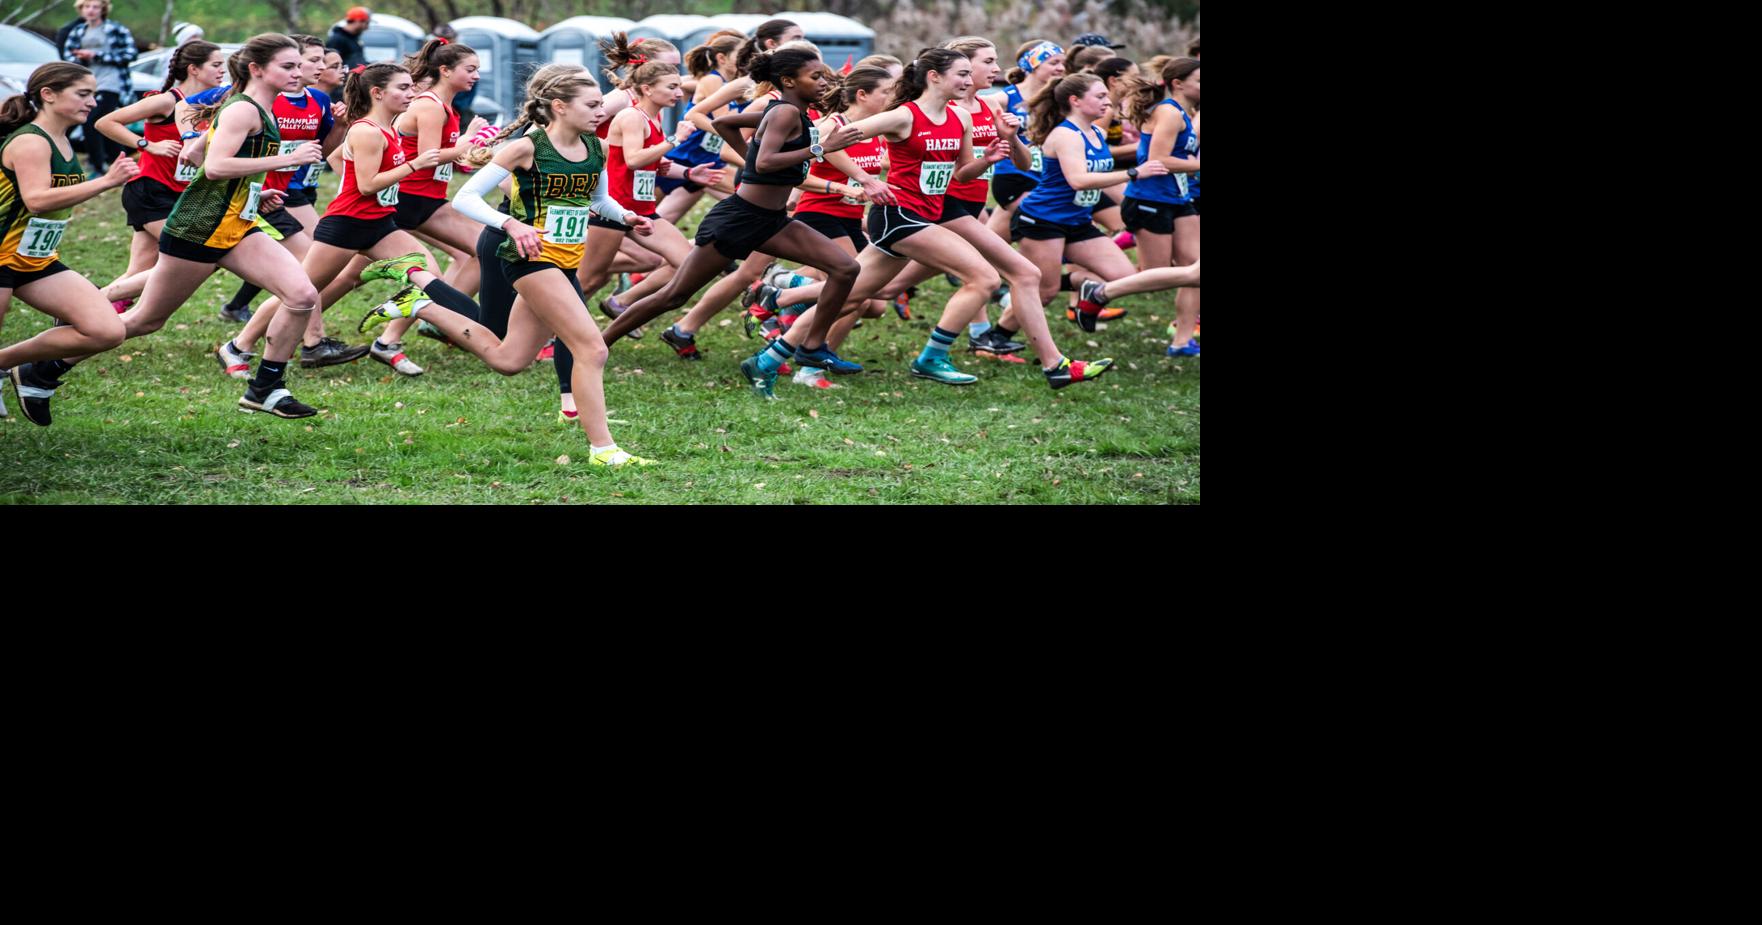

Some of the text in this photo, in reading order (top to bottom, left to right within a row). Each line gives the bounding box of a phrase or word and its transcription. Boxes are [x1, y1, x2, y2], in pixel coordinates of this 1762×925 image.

[925, 138, 960, 151] HAZEN
[926, 170, 951, 188] 461
[553, 216, 586, 237] 191
[28, 229, 62, 250] 190
